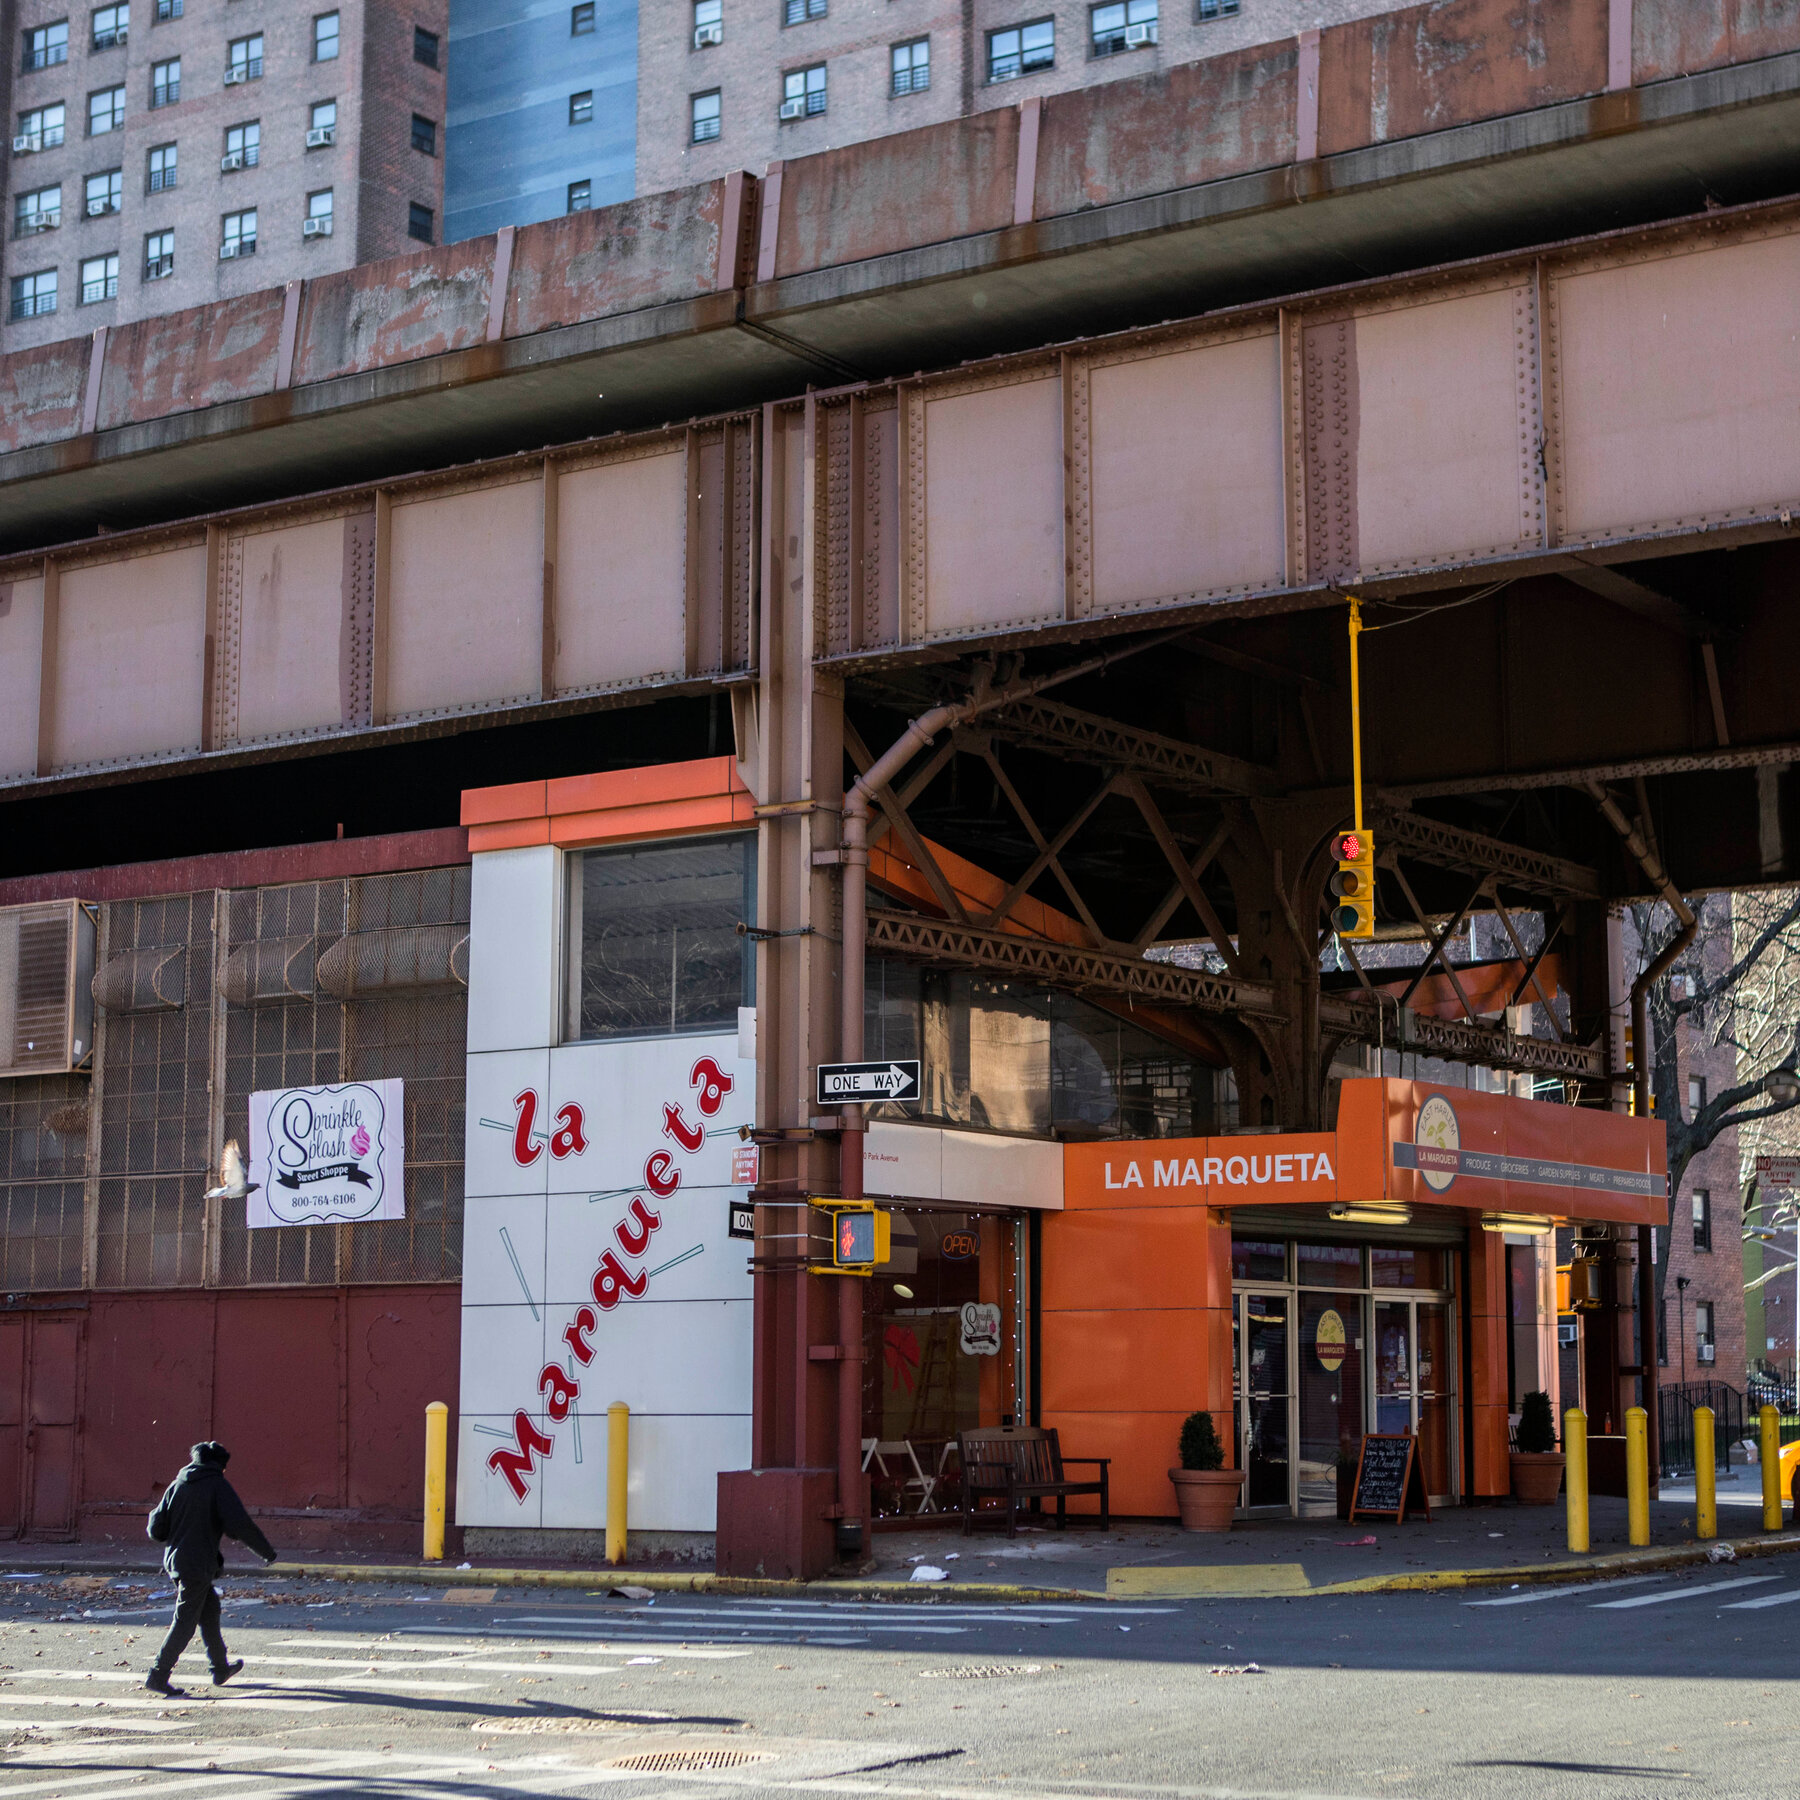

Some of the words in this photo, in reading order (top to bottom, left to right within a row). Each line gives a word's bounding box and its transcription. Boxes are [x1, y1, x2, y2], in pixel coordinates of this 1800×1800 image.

[832, 1076, 861, 1090] ONE
[874, 1073, 903, 1088] WAY
[512, 1087, 589, 1168] la
[1421, 1105, 1433, 1131] EAST
[1434, 1104, 1456, 1136] HARLEM
[278, 1098, 363, 1167] Sprinkle
[736, 1160, 754, 1168] ANYTIME
[868, 1152, 879, 1160] Park
[880, 1153, 899, 1162] Avenue
[1419, 1152, 1426, 1161] LA
[1427, 1152, 1457, 1165] MARQUETA
[1757, 1158, 1770, 1170] NO
[296, 1170, 319, 1183] Sweet
[320, 1165, 349, 1179] Shoppe
[1105, 1161, 1144, 1189] LA
[1153, 1152, 1335, 1186] MARQUETA
[1465, 1158, 1491, 1171] PRODUCE
[1500, 1162, 1529, 1175] GROCERIES
[1538, 1166, 1560, 1178] GARDEN
[1559, 1168, 1581, 1181] SUPPLIES
[1589, 1172, 1605, 1184] MEATS
[1613, 1175, 1635, 1188] PREPARED
[1635, 1177, 1651, 1189] FOODS
[1765, 1171, 1796, 1179] ANYTIME
[291, 1193, 356, 1208] 800-764-6106
[739, 1213, 754, 1228] ON
[943, 1234, 977, 1255] OPEN
[486, 1055, 734, 1505] Marqueta
